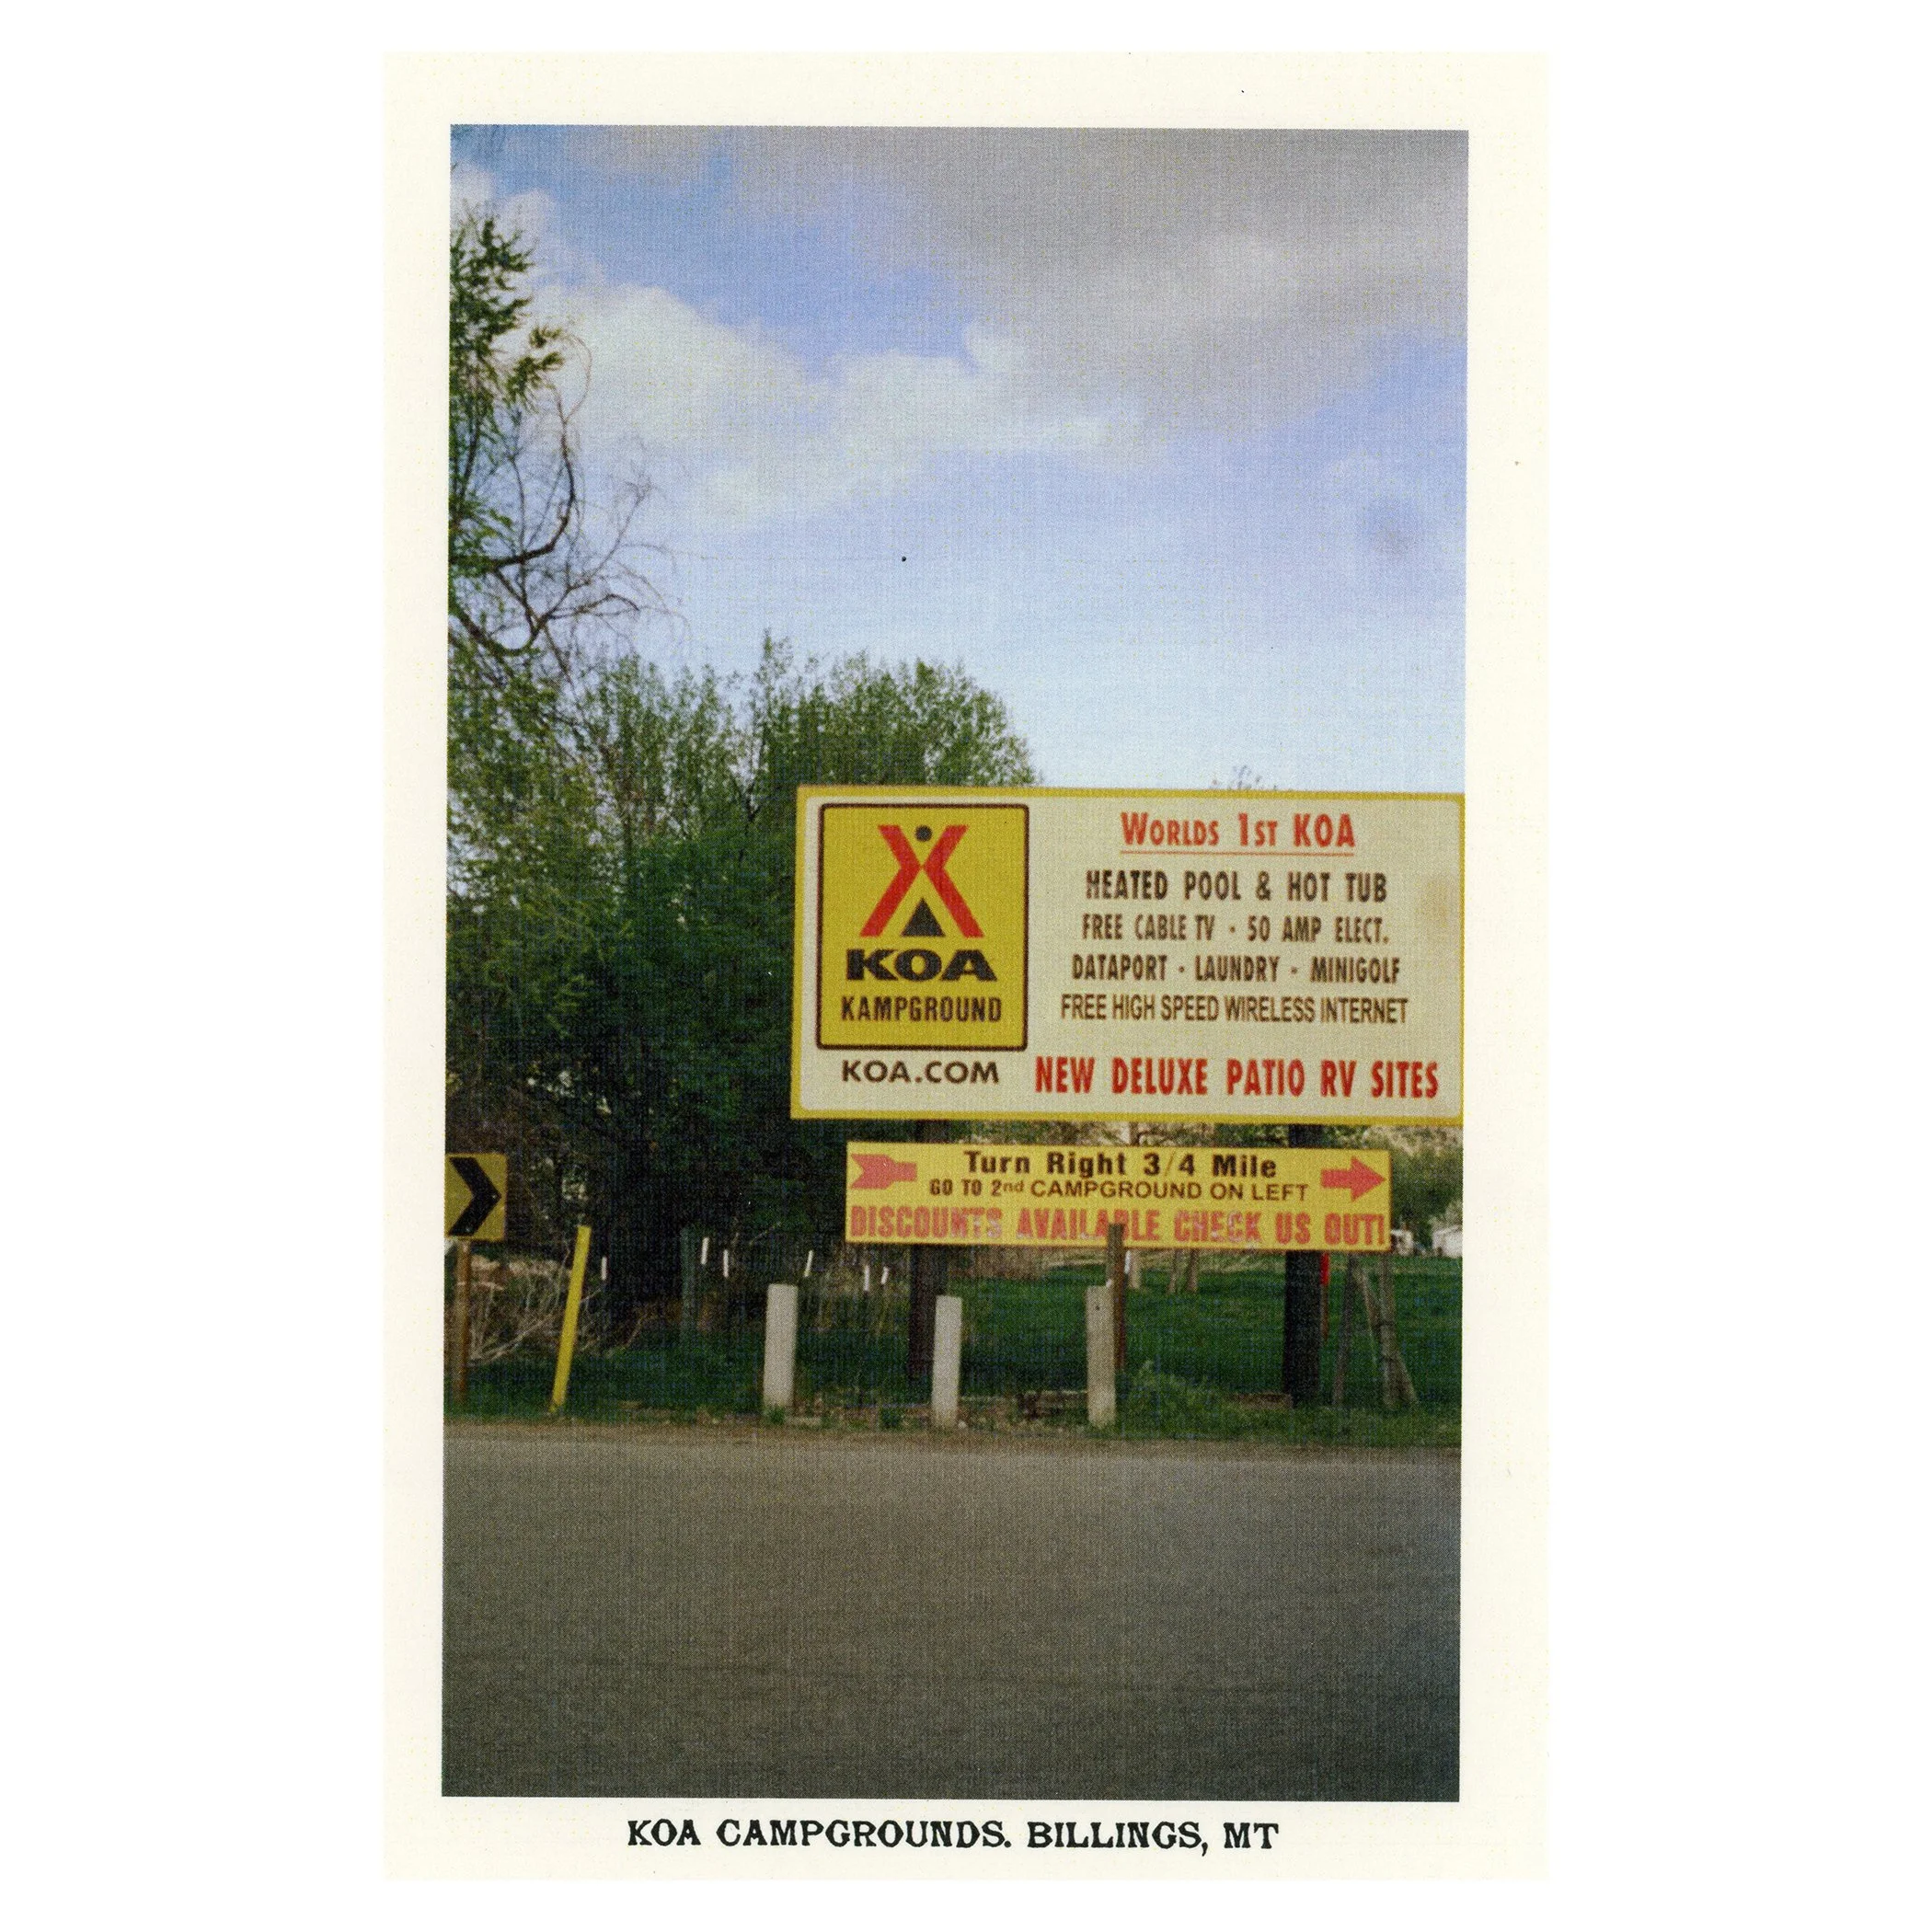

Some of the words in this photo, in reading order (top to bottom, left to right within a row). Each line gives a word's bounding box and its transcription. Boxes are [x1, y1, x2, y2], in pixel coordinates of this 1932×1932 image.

[1294, 814, 1356, 847] KOA
[1086, 870, 1168, 901] HEATED
[1184, 871, 1241, 901] POOL
[1256, 871, 1271, 901] &
[1288, 872, 1331, 902] HOT
[1346, 873, 1387, 903] TUB
[1082, 914, 1123, 940] FREE
[1134, 914, 1187, 940] CABLE
[1195, 915, 1215, 940] TV
[1248, 915, 1271, 941] 50
[1282, 916, 1321, 942] AMP
[1335, 917, 1390, 943] ELECT.
[845, 949, 997, 981] KOA
[1072, 954, 1168, 981] DATAPORT
[1195, 955, 1281, 983] LAUNDRY
[1310, 957, 1400, 983] MINIGOLF
[841, 995, 1003, 1023] KAMPGROUND
[1061, 995, 1107, 1020] FREE
[1112, 995, 1155, 1020] HIGH
[1160, 995, 1219, 1021] SPEED
[1225, 996, 1316, 1023] WIRELESS
[1320, 998, 1409, 1024] INTERNET
[842, 1060, 1000, 1084] KOA.COM
[1035, 1056, 1096, 1093] NEW
[1111, 1057, 1208, 1095] DELUXE
[1227, 1059, 1305, 1097] PATIO
[1320, 1061, 1357, 1097] RV
[1371, 1061, 1439, 1098] SITES
[965, 1150, 1030, 1174] Turn
[1047, 1151, 1127, 1179] Right
[1144, 1153, 1197, 1178] 3/4
[1212, 1155, 1277, 1179] Mile
[929, 1179, 953, 1196] GO
[961, 1179, 982, 1197] TO
[992, 1179, 1024, 1197] 2nd
[1030, 1179, 1202, 1200] CAMPGROUND
[1210, 1183, 1243, 1200] ON
[1251, 1183, 1309, 1202] LEFT
[850, 1205, 1002, 1238] DISCOUNTS
[1173, 1209, 1263, 1243] CHECK
[1274, 1212, 1312, 1244] US
[1324, 1213, 1386, 1246] OUT!
